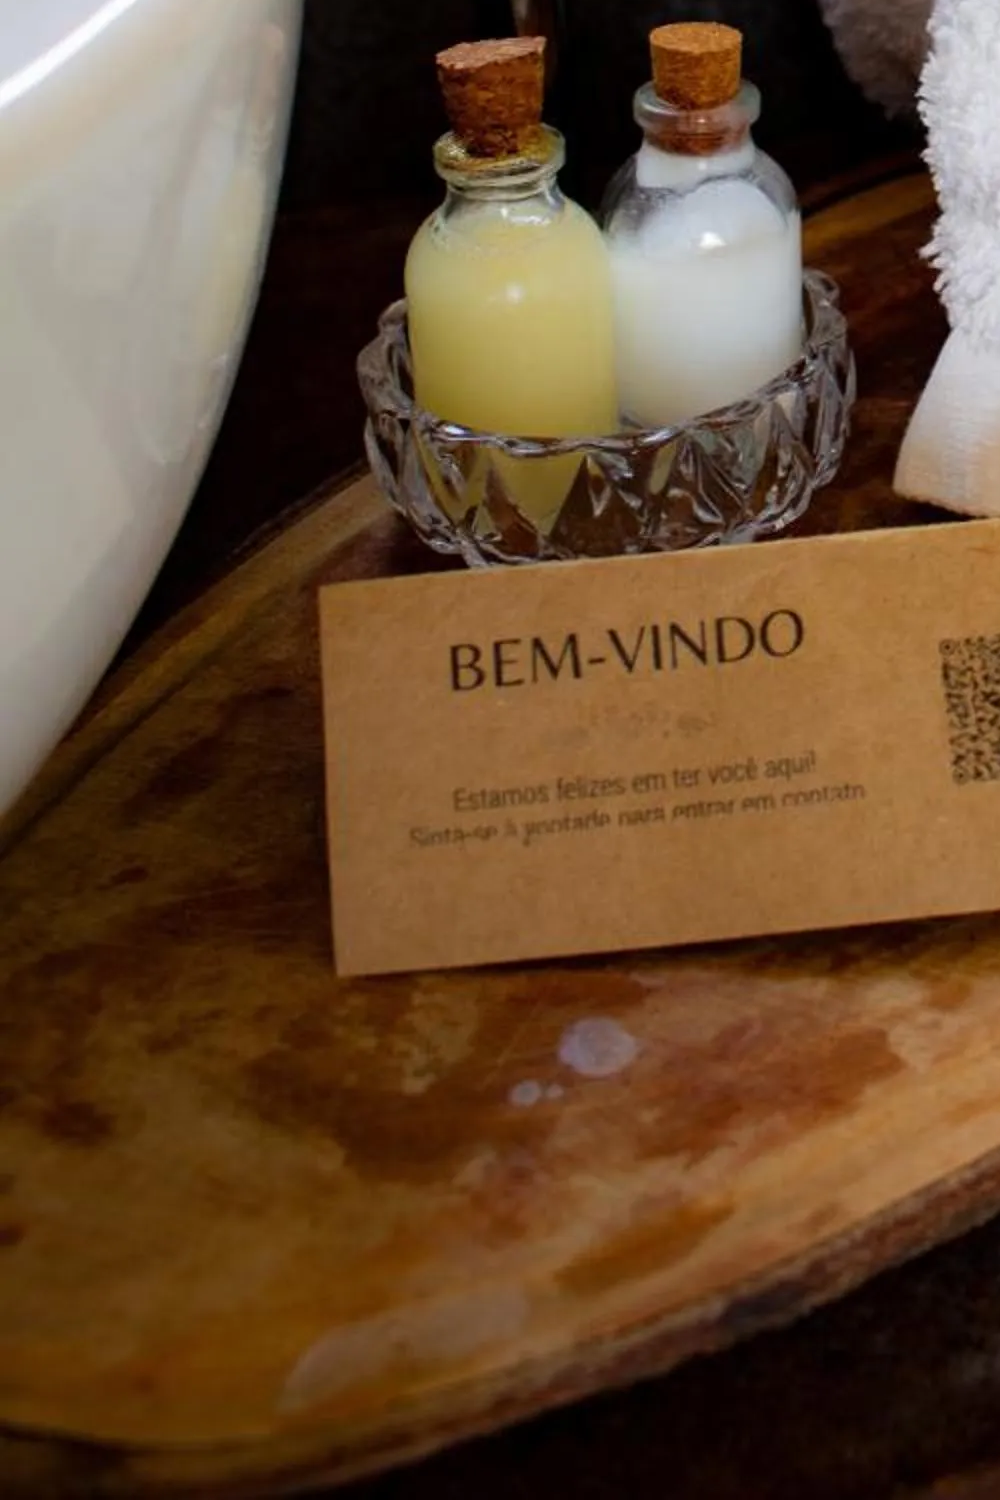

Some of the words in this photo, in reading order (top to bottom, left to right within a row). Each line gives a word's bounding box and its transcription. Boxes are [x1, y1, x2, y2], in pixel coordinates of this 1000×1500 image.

[450, 608, 804, 692] BEM-VINDO
[452, 784, 551, 812] Estamos
[556, 773, 627, 802] felizes
[631, 771, 667, 793] em
[672, 765, 701, 789] ter
[707, 756, 758, 786] você
